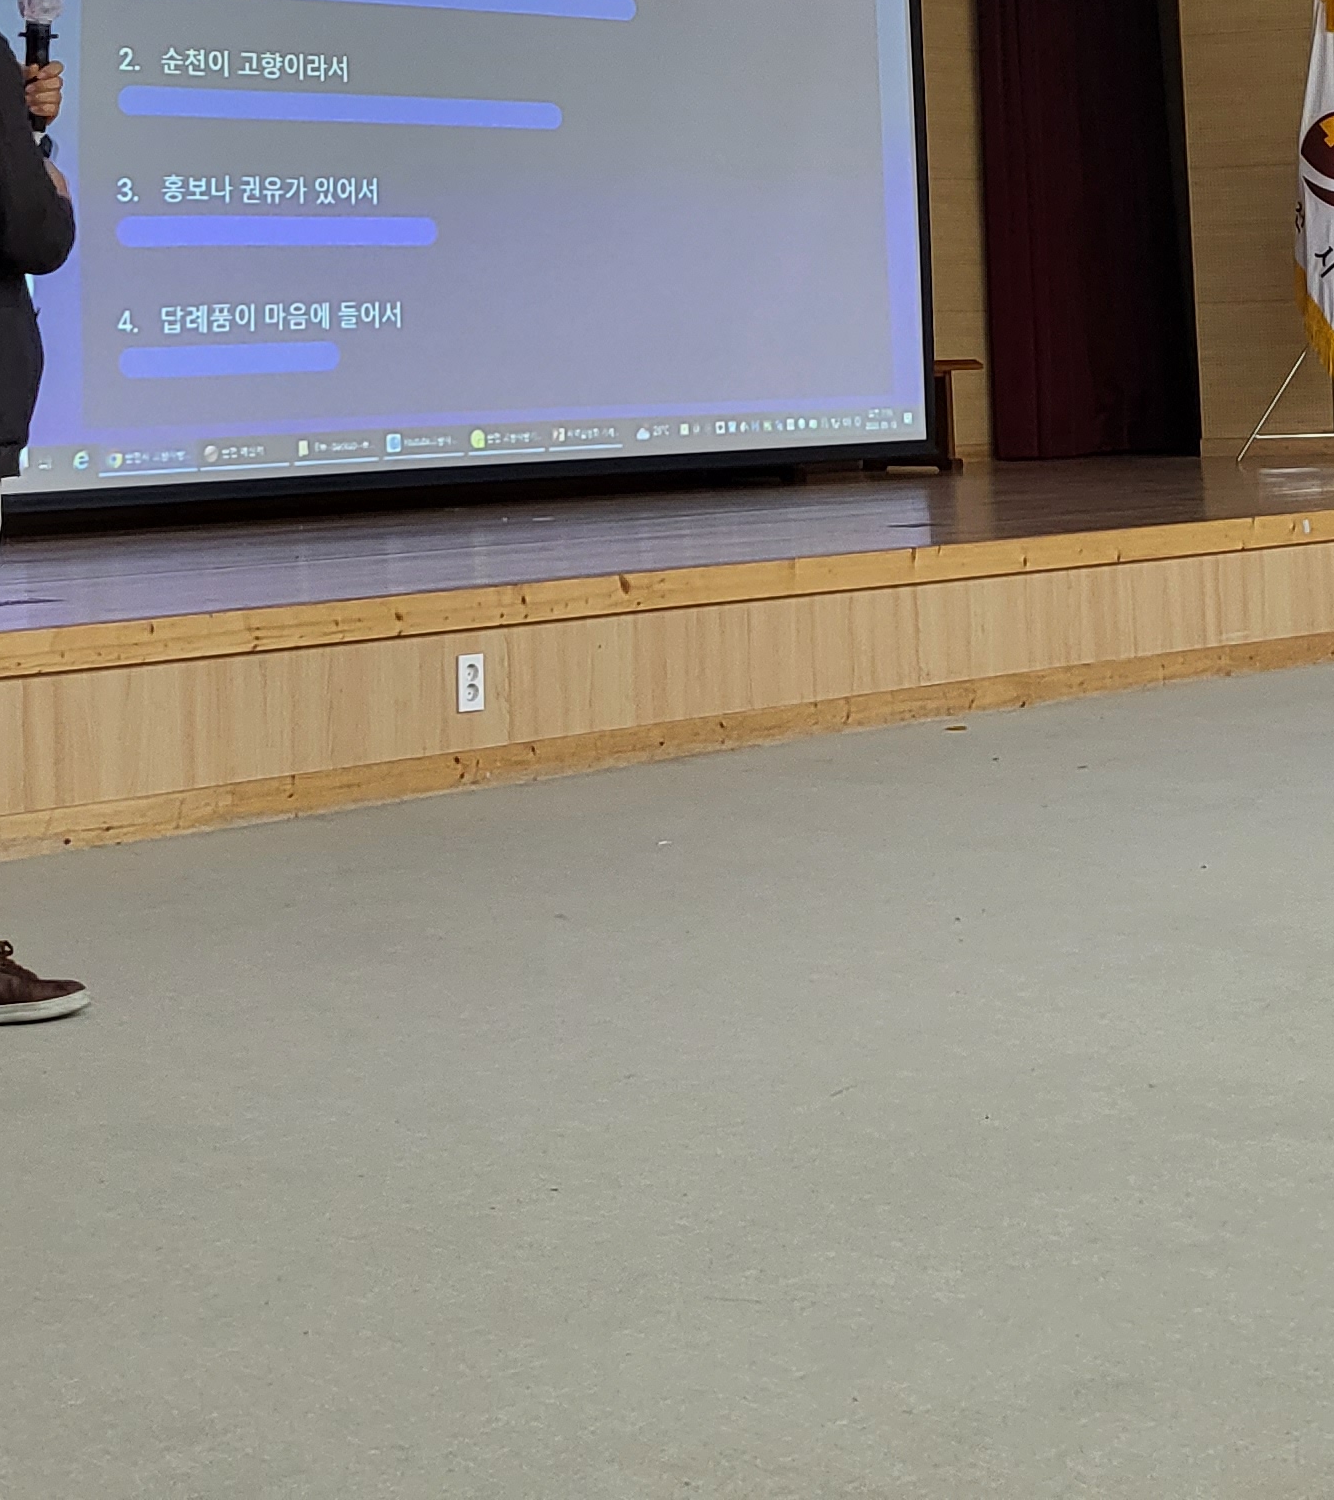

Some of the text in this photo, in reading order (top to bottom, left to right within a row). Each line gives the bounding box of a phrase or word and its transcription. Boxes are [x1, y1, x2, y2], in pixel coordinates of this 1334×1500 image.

[118, 47, 349, 83] 2. 순천이 고향이라서
[116, 173, 379, 205] 3. 홍보나 권유가 있어서
[117, 300, 403, 335] 4. 답례품이 마음에 들어서
